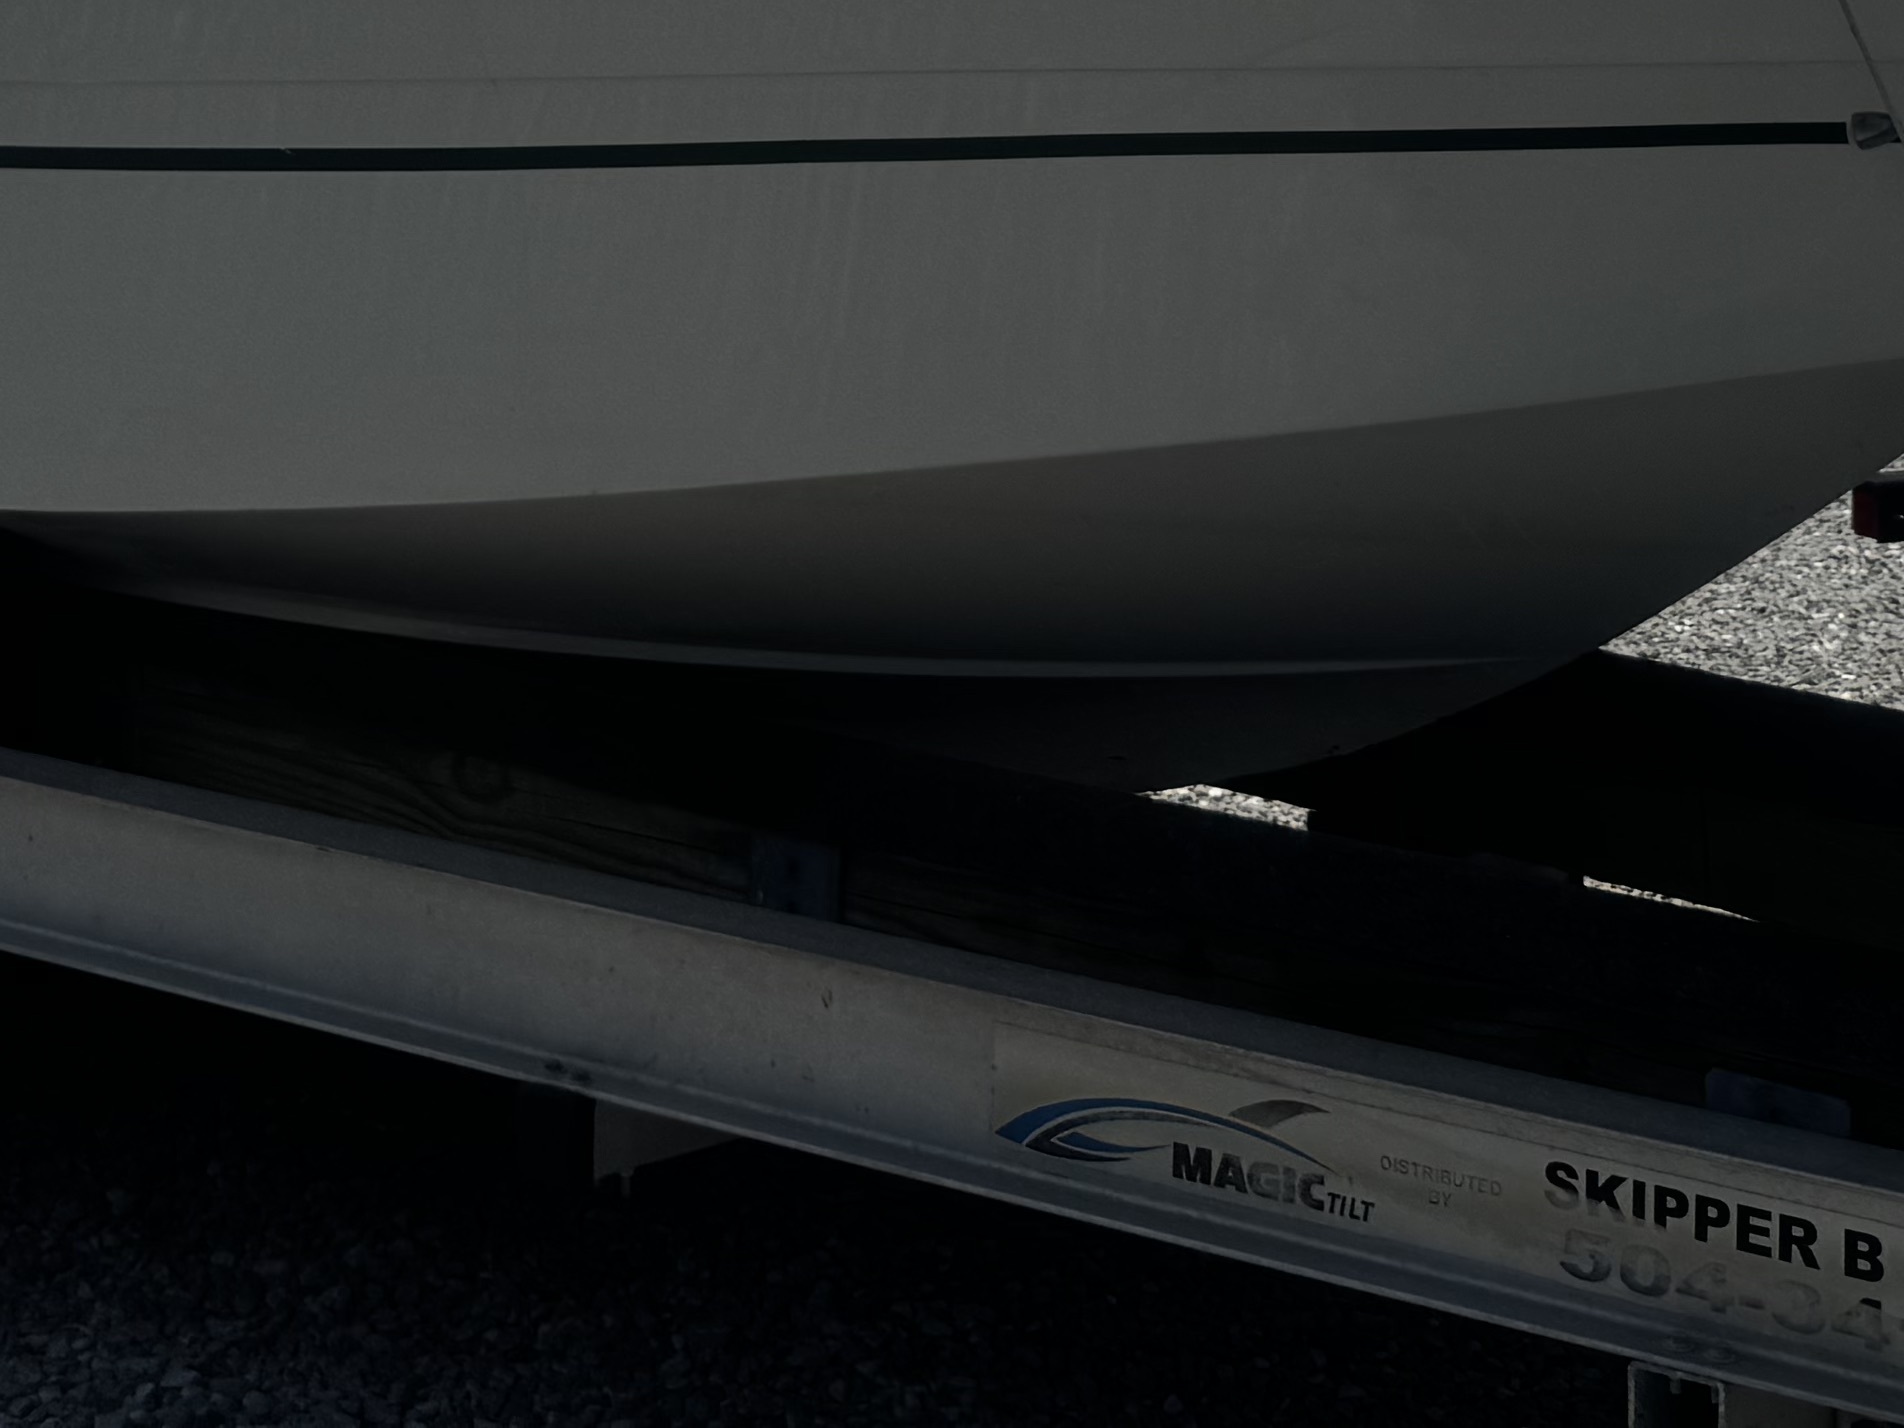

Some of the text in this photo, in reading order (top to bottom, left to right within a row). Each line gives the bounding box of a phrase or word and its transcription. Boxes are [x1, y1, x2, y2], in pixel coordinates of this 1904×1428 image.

[1172, 1142, 1375, 1222] MAGIC TILT
[1380, 1155, 1502, 1196] DISTRIBUTED
[1544, 1161, 1821, 1270] SKIPPER
[1844, 1228, 1884, 1282] B
